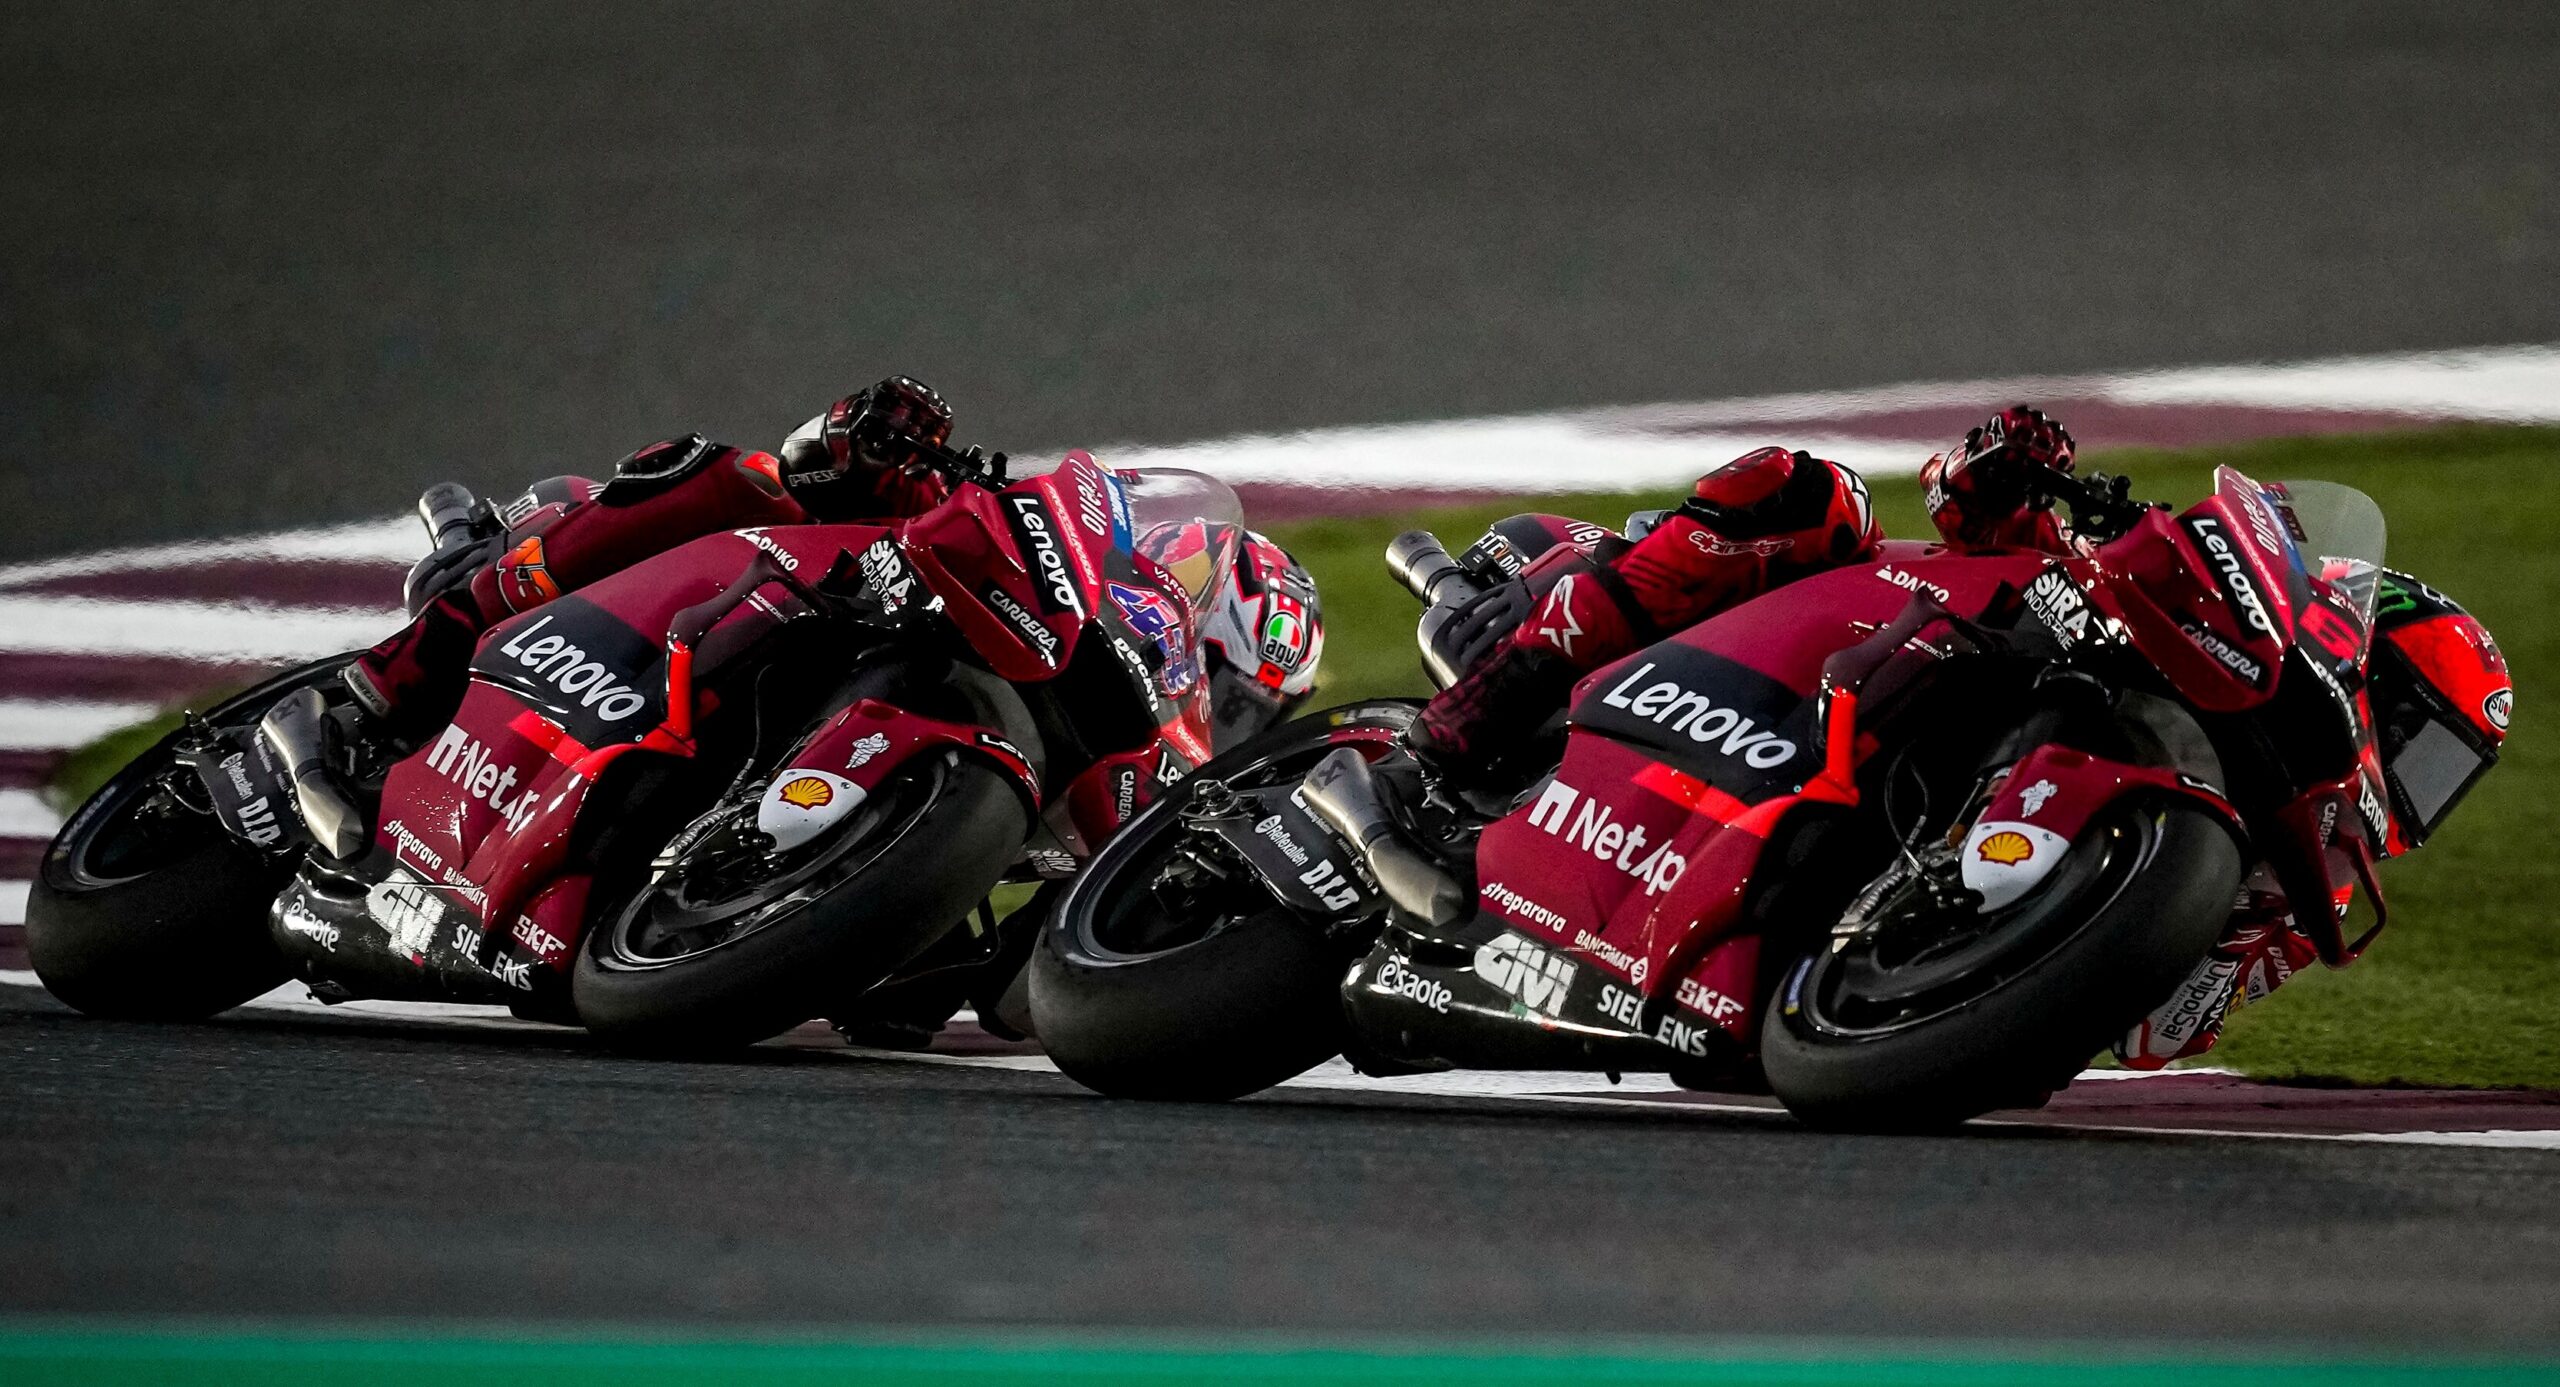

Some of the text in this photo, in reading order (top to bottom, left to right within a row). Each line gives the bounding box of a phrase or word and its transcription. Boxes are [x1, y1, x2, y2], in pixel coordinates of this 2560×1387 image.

[759, 536, 799, 572] DAIKO
[869, 540, 911, 598] SIRA
[1013, 498, 1077, 606] Lenovo
[2192, 518, 2268, 631] Lenovo
[989, 589, 1058, 650] CARRERA
[2035, 572, 2090, 632] SIRA
[500, 615, 645, 721] Lenovo
[1114, 636, 1159, 713] DUCATI
[1264, 638, 1297, 664] agv
[2181, 623, 2260, 681] CARRERA
[1602, 661, 1797, 770] Lenovo
[383, 819, 443, 871] streparava
[1266, 824, 1310, 867] Reflexallen
[512, 914, 568, 956] SKF
[1480, 881, 1568, 933] streparava
[451, 923, 533, 992] SIEENS
[1473, 932, 1580, 1018] GIVI
[1574, 928, 1636, 972] BANCOMAT
[1376, 953, 1453, 1014] esaote
[1674, 976, 1745, 1020] SKF
[2159, 960, 2238, 1042] UnipolSai
